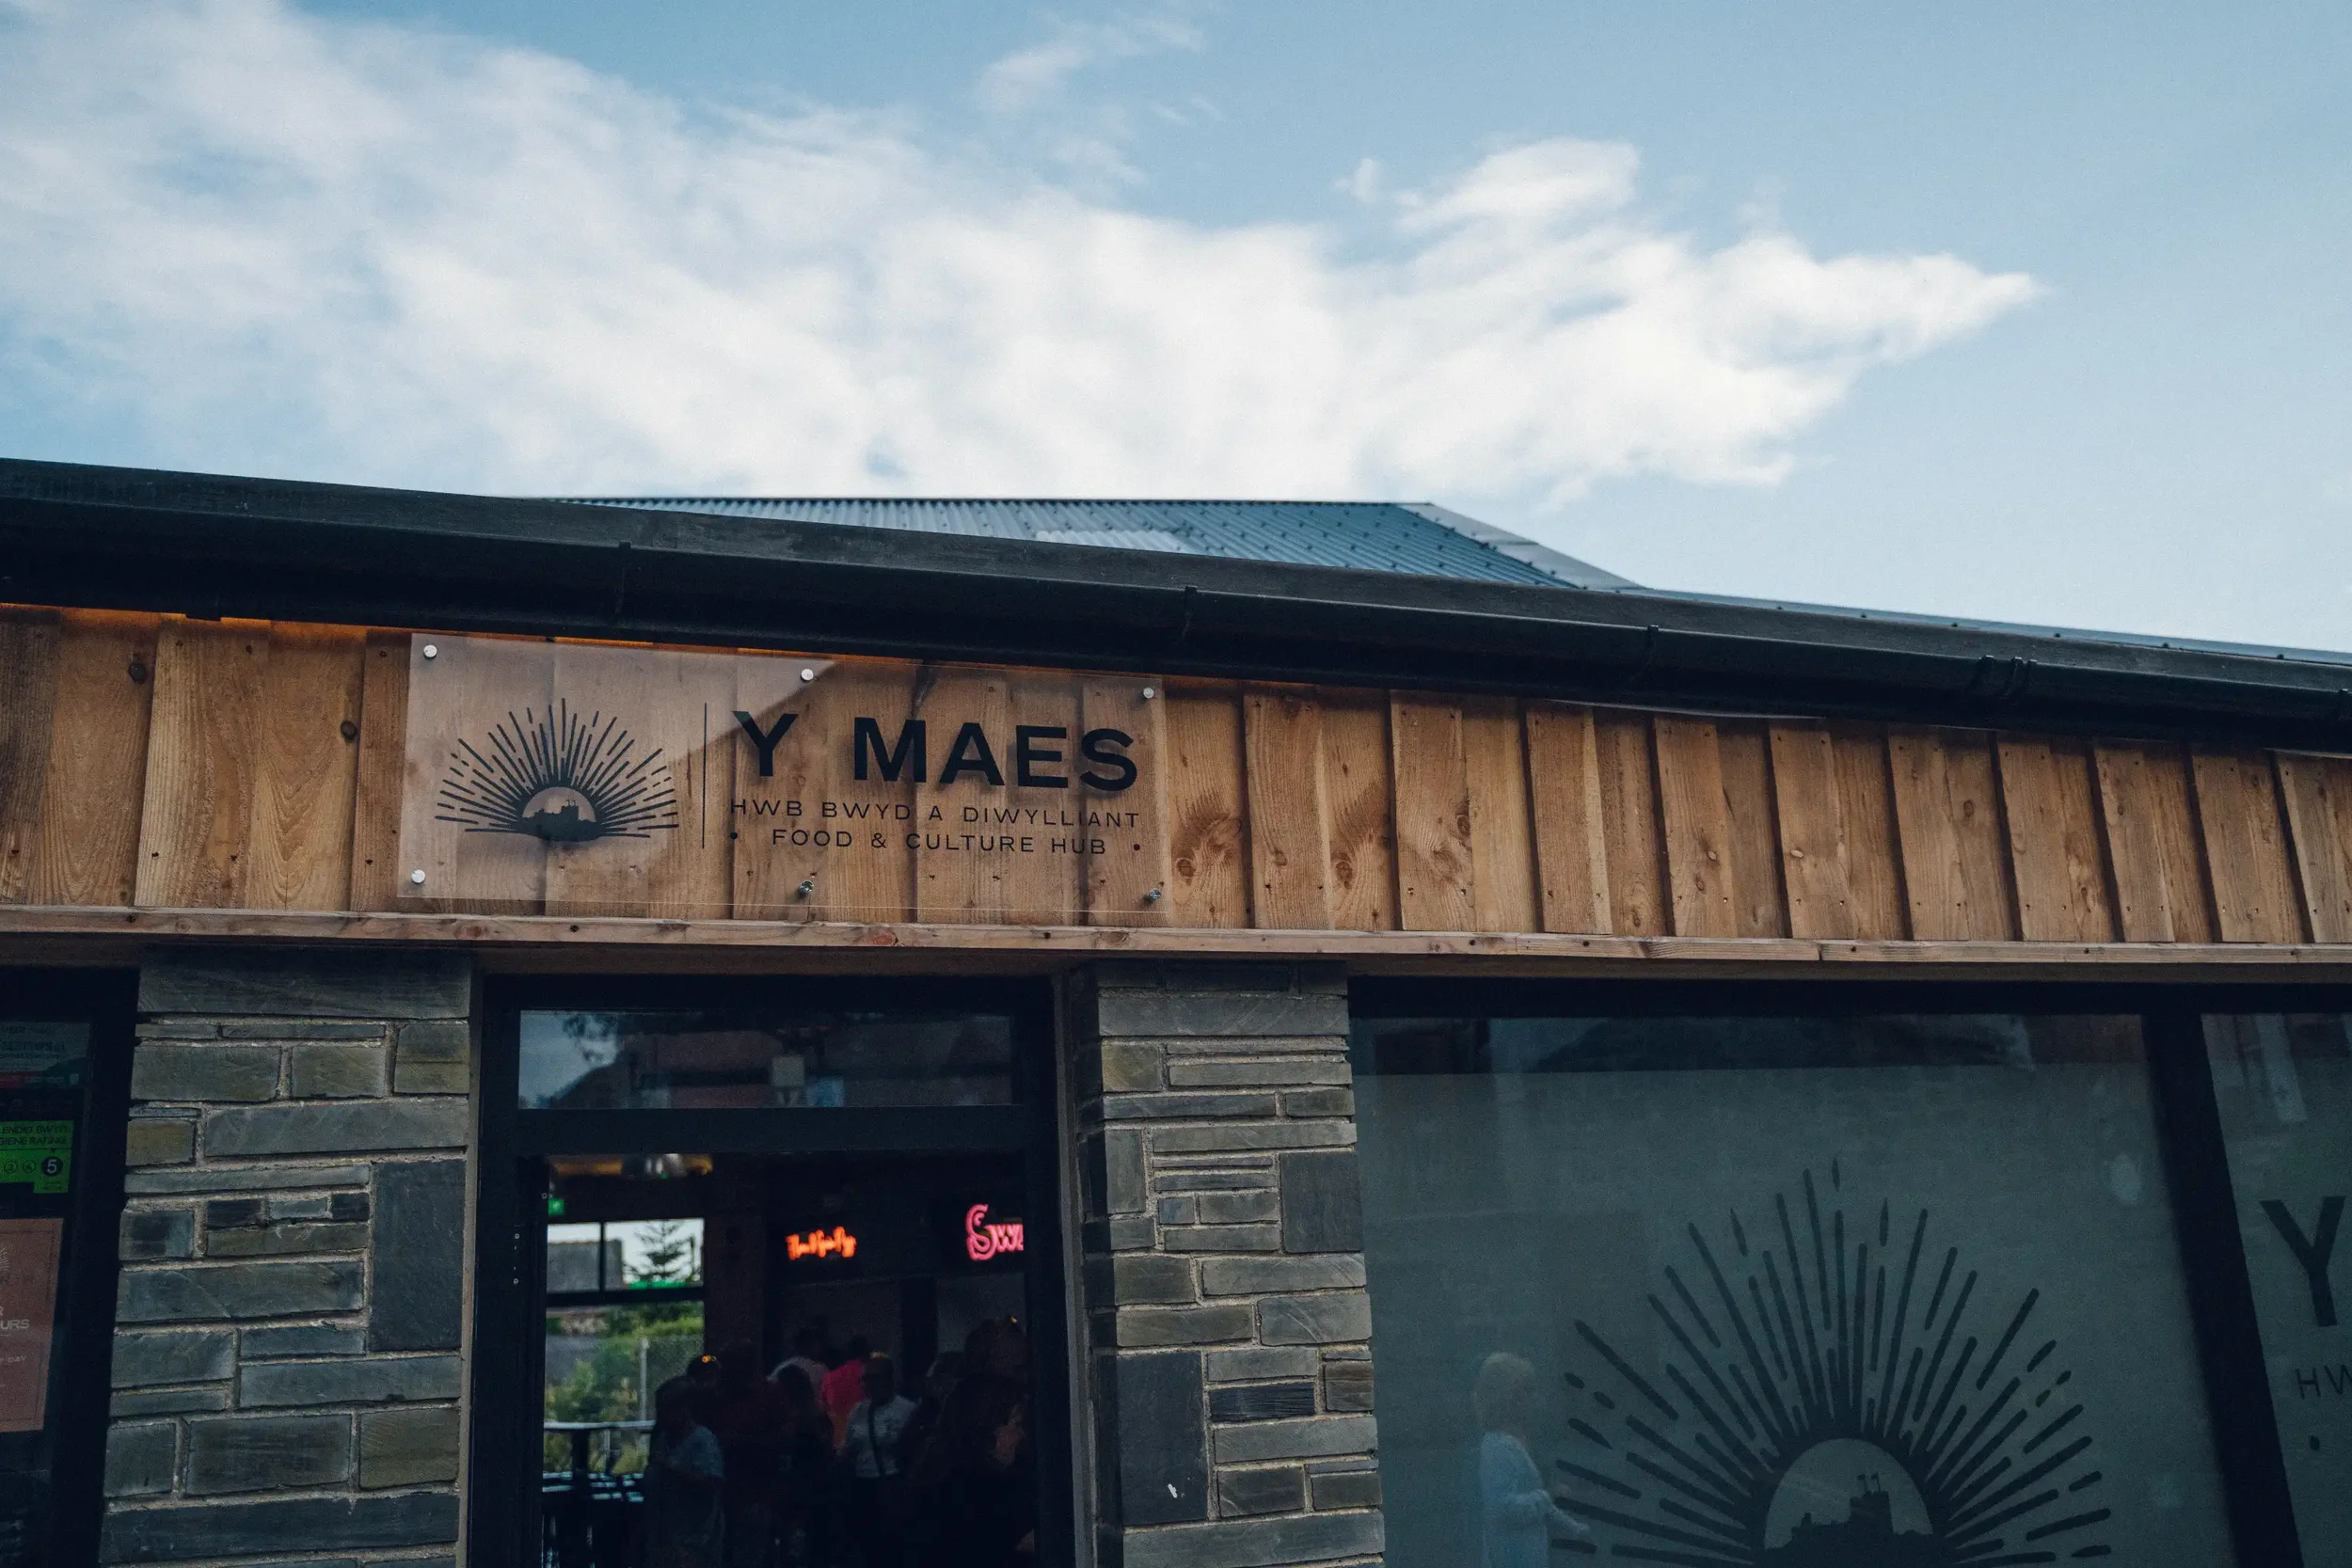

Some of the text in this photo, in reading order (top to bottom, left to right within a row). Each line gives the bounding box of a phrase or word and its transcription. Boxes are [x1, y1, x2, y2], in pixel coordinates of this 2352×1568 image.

[733, 711, 1138, 792] Y MAES
[730, 799, 1139, 829] HWB BWYD A DIWYLLIANT
[772, 829, 1105, 855] FOOD & CULTURE HUB
[47, 1158, 57, 1174] 5
[2259, 1195, 2346, 1327] Y
